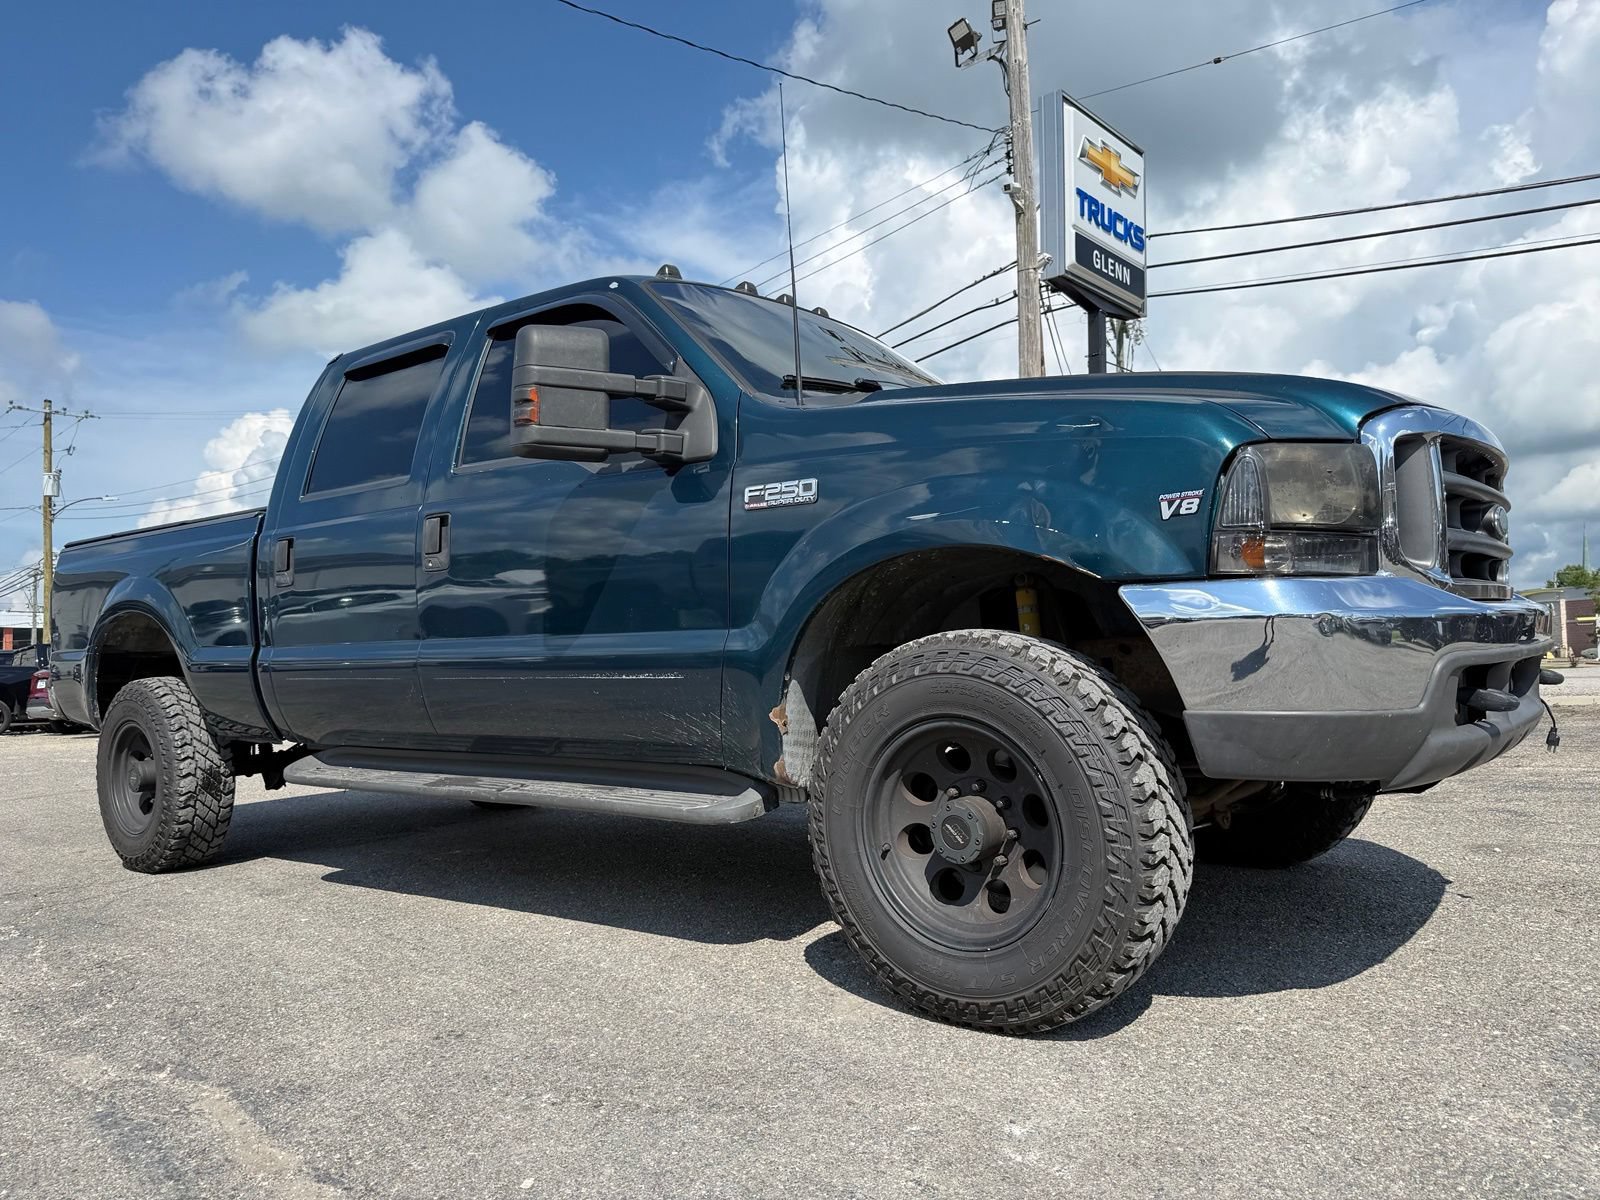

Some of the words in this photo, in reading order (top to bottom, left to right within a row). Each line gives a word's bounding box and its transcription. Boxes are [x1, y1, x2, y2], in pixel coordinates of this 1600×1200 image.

[1076, 187, 1145, 253] TRUCKS
[1093, 250, 1131, 286] GLENN
[768, 498, 793, 506] SUPER
[794, 495, 816, 503] DUTY
[1159, 492, 1180, 500] POWER
[1180, 489, 1203, 498] STROKE
[1160, 498, 1200, 520] V8
[1026, 786, 1094, 976] DISCOVERER
